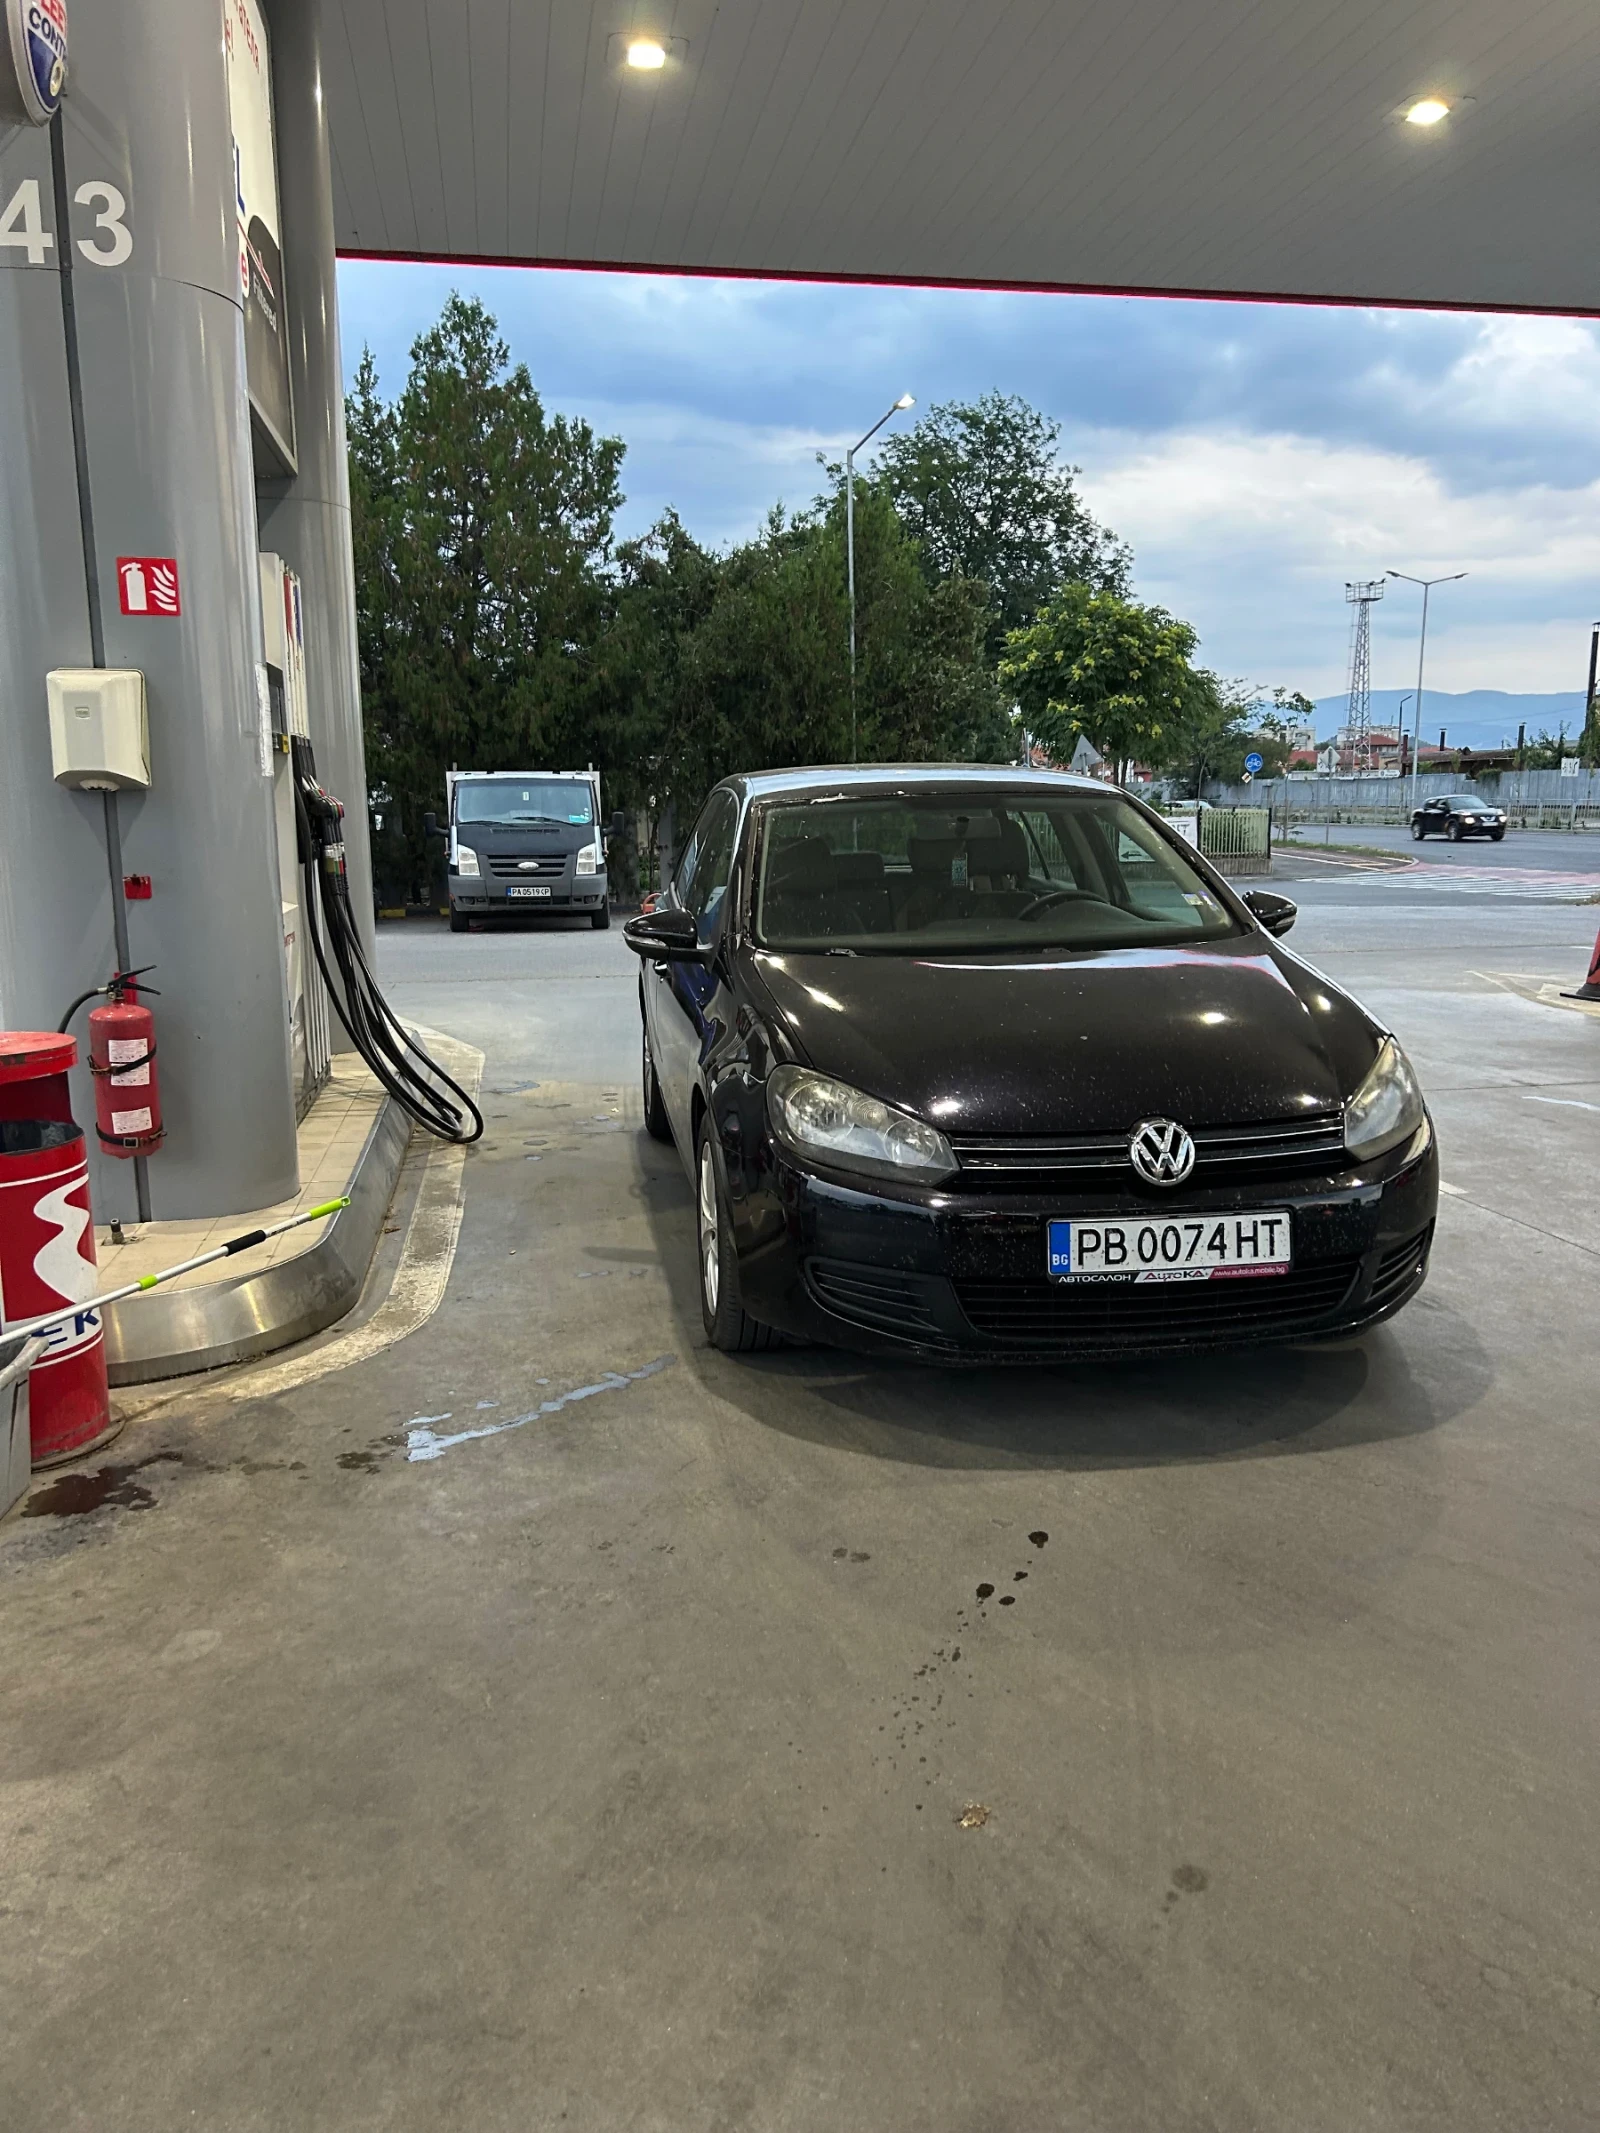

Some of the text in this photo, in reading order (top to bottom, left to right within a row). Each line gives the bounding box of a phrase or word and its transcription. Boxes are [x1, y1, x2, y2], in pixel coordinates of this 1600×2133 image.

[0, 179, 133, 267] 4 3
[1052, 1253, 1069, 1266] BG
